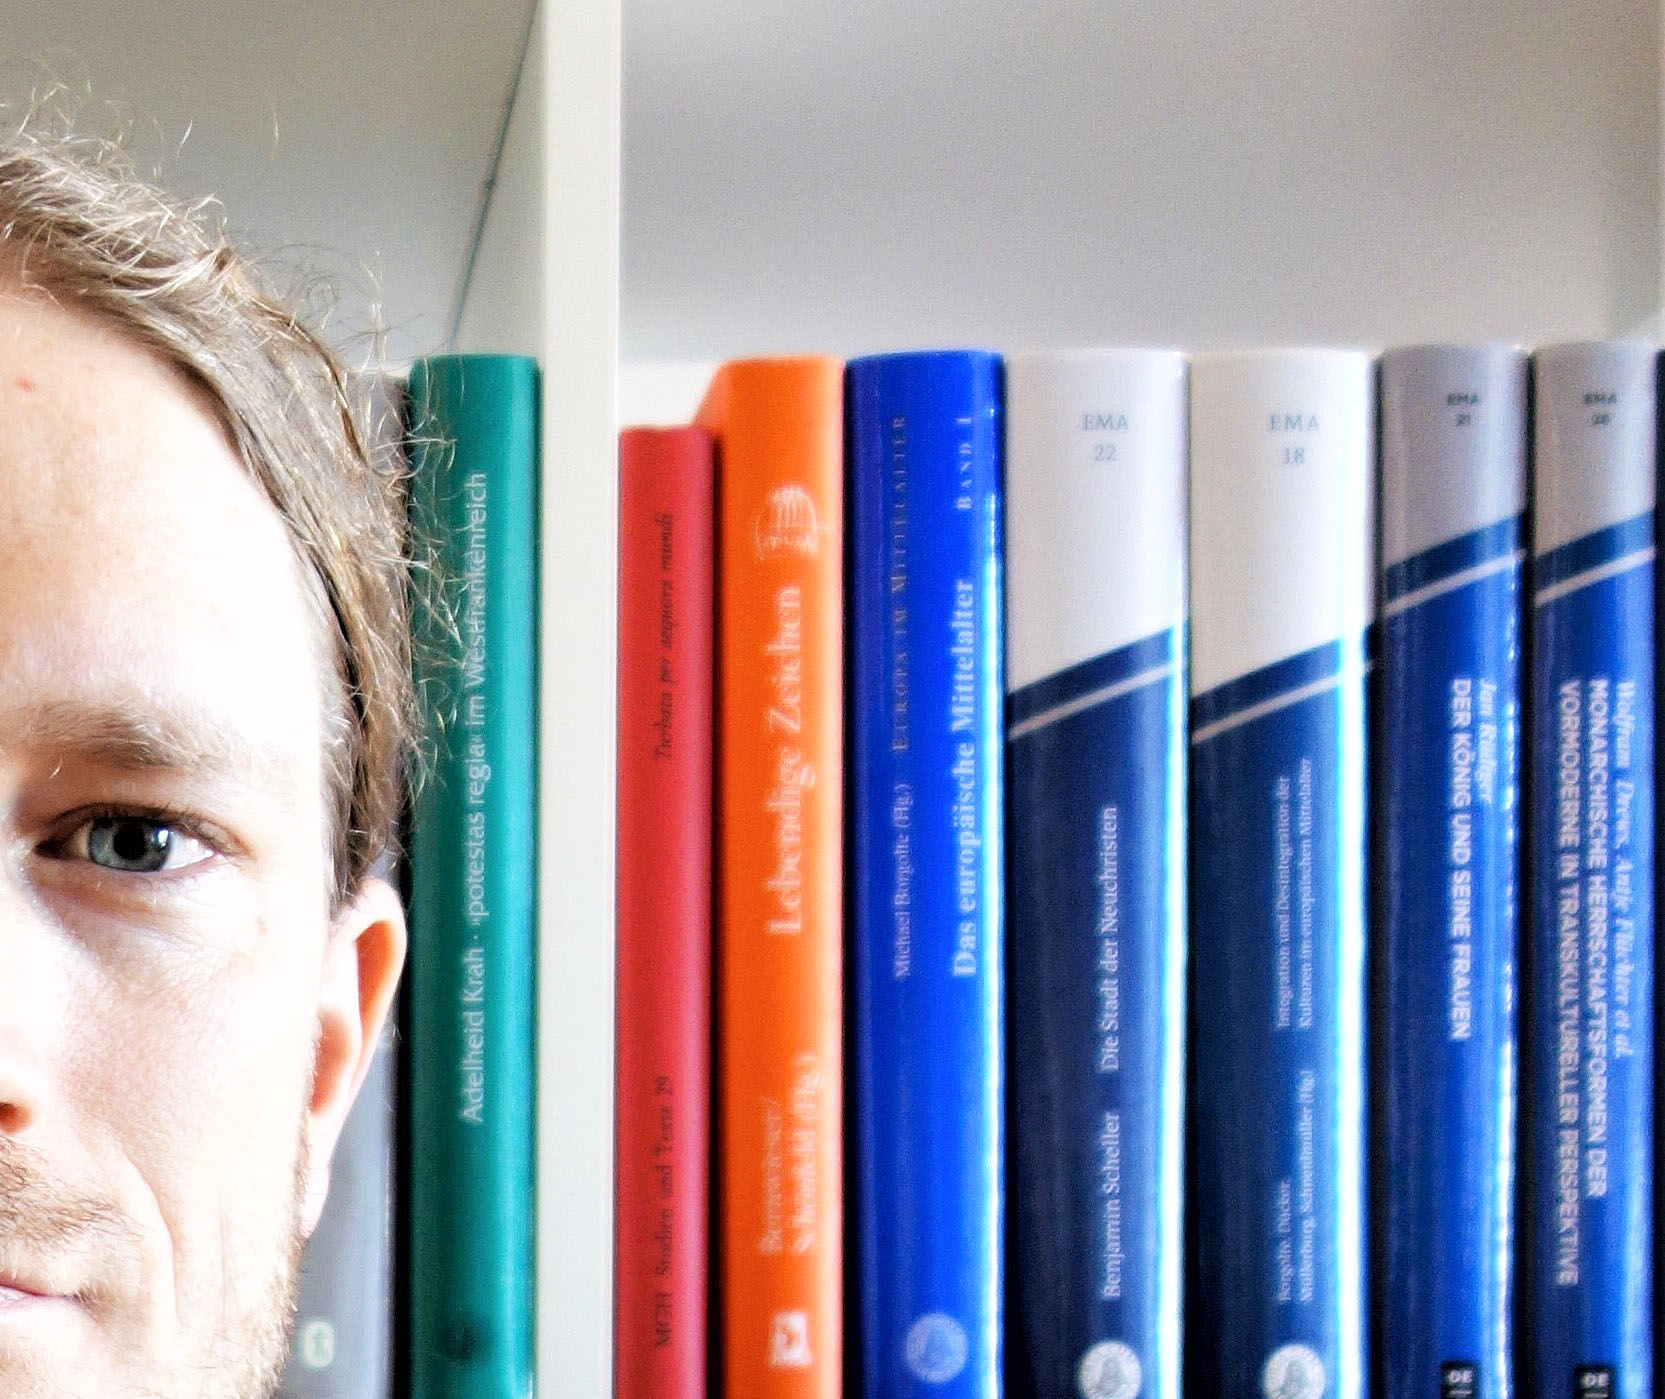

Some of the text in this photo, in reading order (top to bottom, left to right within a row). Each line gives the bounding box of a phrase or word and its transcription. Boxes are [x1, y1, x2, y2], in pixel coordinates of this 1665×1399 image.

[1081, 414, 1129, 431] EMA
[1268, 414, 1320, 431] EMA
[1446, 392, 1479, 406] EMA
[1582, 392, 1617, 406] EMA
[890, 414, 909, 593] MITTELALTER
[956, 441, 974, 509] BAND
[1094, 444, 1117, 461] 22
[1282, 447, 1305, 464] 18
[463, 474, 487, 688] Westfrankenreich
[464, 696, 486, 725] im
[892, 649, 909, 752] EUROPA
[1479, 681, 1498, 716] Jan
[766, 585, 815, 933] Lebendige Zeichen
[950, 580, 981, 975] Das europäische Mittelalter
[892, 783, 914, 979] Michael Borgolte (Hg.)
[1275, 777, 1293, 1028] Integration und Desintegration der
[1297, 759, 1316, 1028] Kulturen im europäischen Mittelalter
[1451, 679, 1476, 1040] DER KÖNIG UND SEINE FRAUEN
[461, 949, 484, 1002] Krah
[1097, 806, 1121, 1071] Die Stadt der Neuchristen
[1559, 680, 1580, 1287] VORMODERNE IN TRANSKULTURELLER PERSPEKTIVE
[1587, 679, 1609, 1197] MONARCHISCHE HERRSCHAFTSFORMEN DER
[461, 1012, 484, 1122] Adelheid
[654, 1165, 674, 1199] und
[1101, 1111, 1125, 1299] Benjamin Scheller
[1447, 1369, 1473, 1384] DE
[1581, 1372, 1610, 1389] DE
